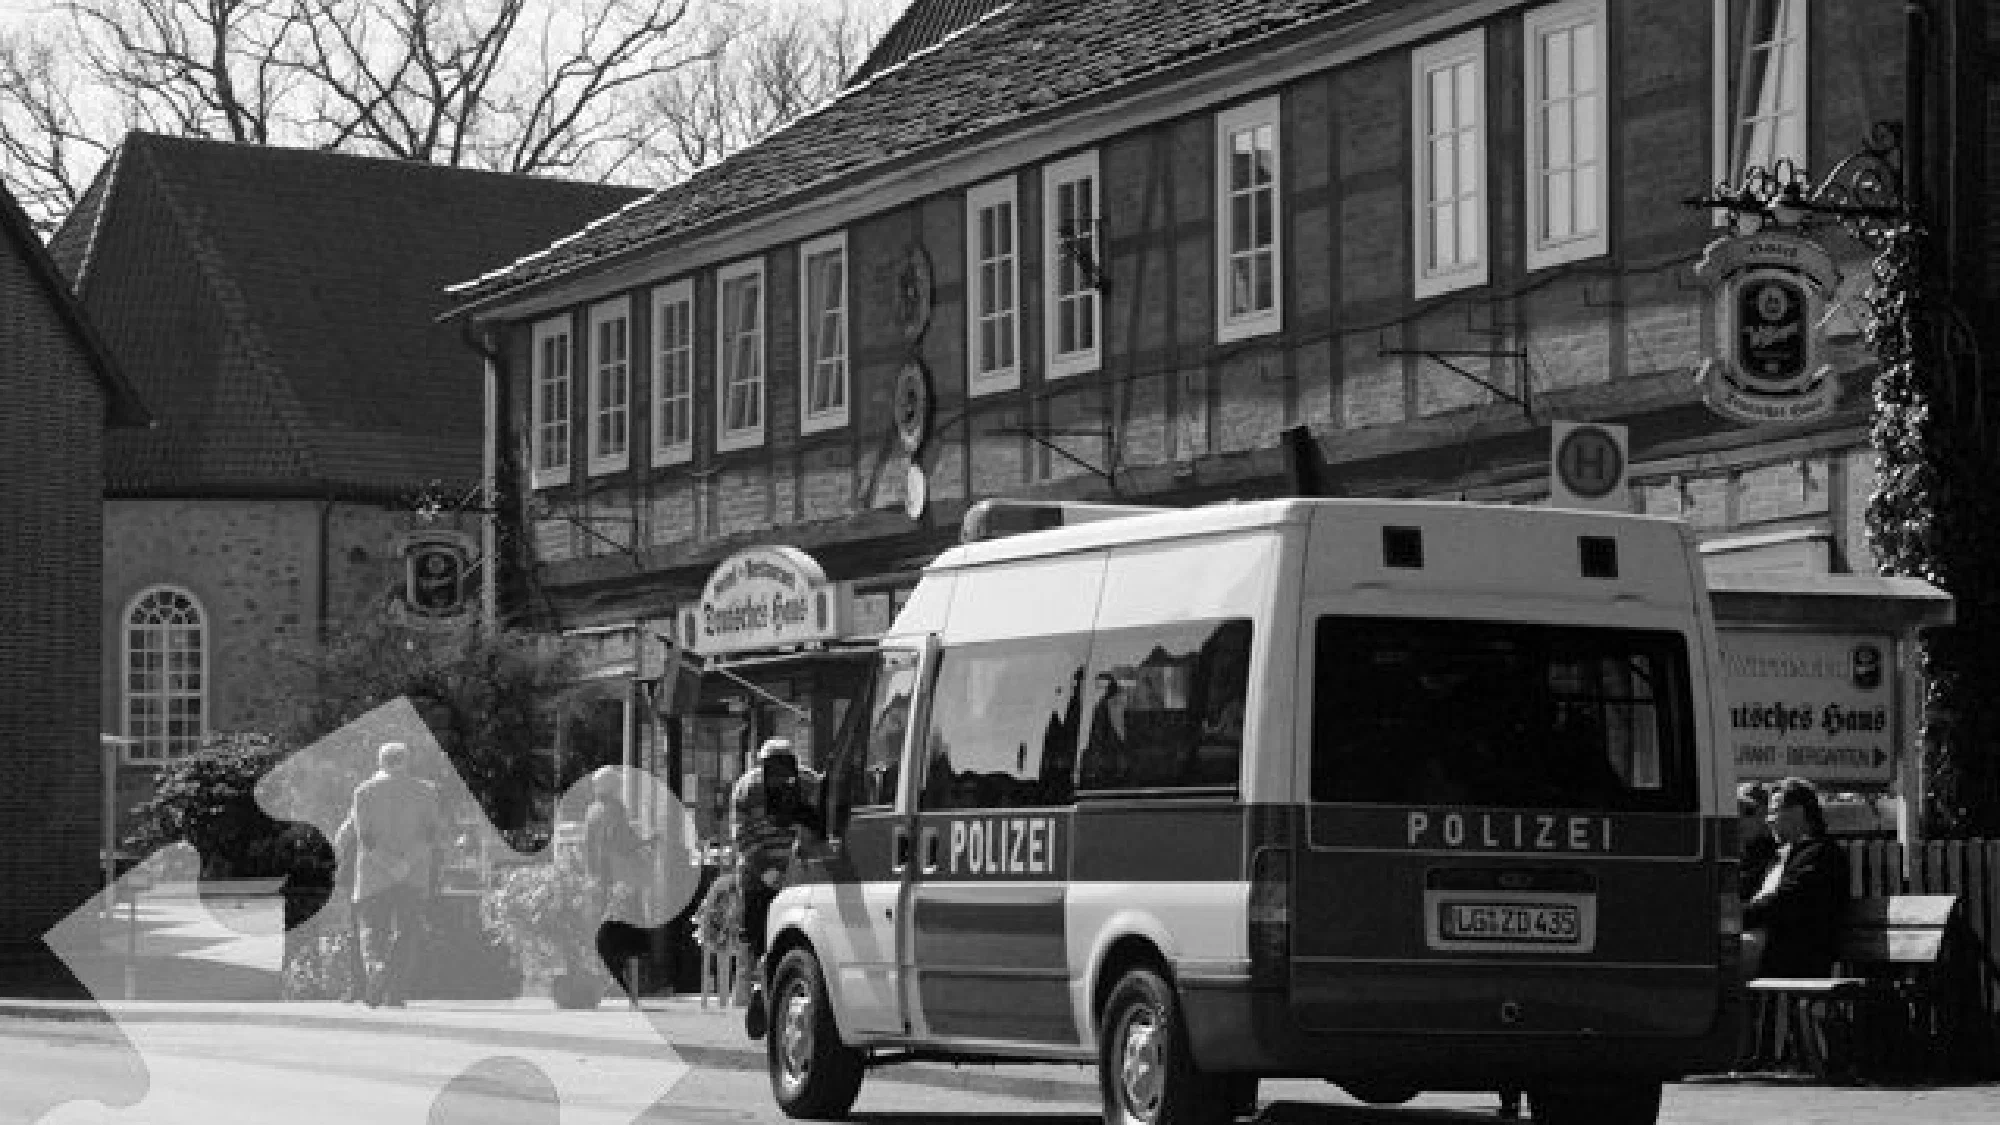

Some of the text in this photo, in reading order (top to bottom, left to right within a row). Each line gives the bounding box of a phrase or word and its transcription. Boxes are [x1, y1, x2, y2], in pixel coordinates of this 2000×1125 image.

[1576, 445, 1604, 480] H
[1822, 702, 1887, 736] Haus
[951, 818, 1056, 874] POLIZEI
[1407, 811, 1611, 851] POLIZEI
[1535, 910, 1577, 936] 435
